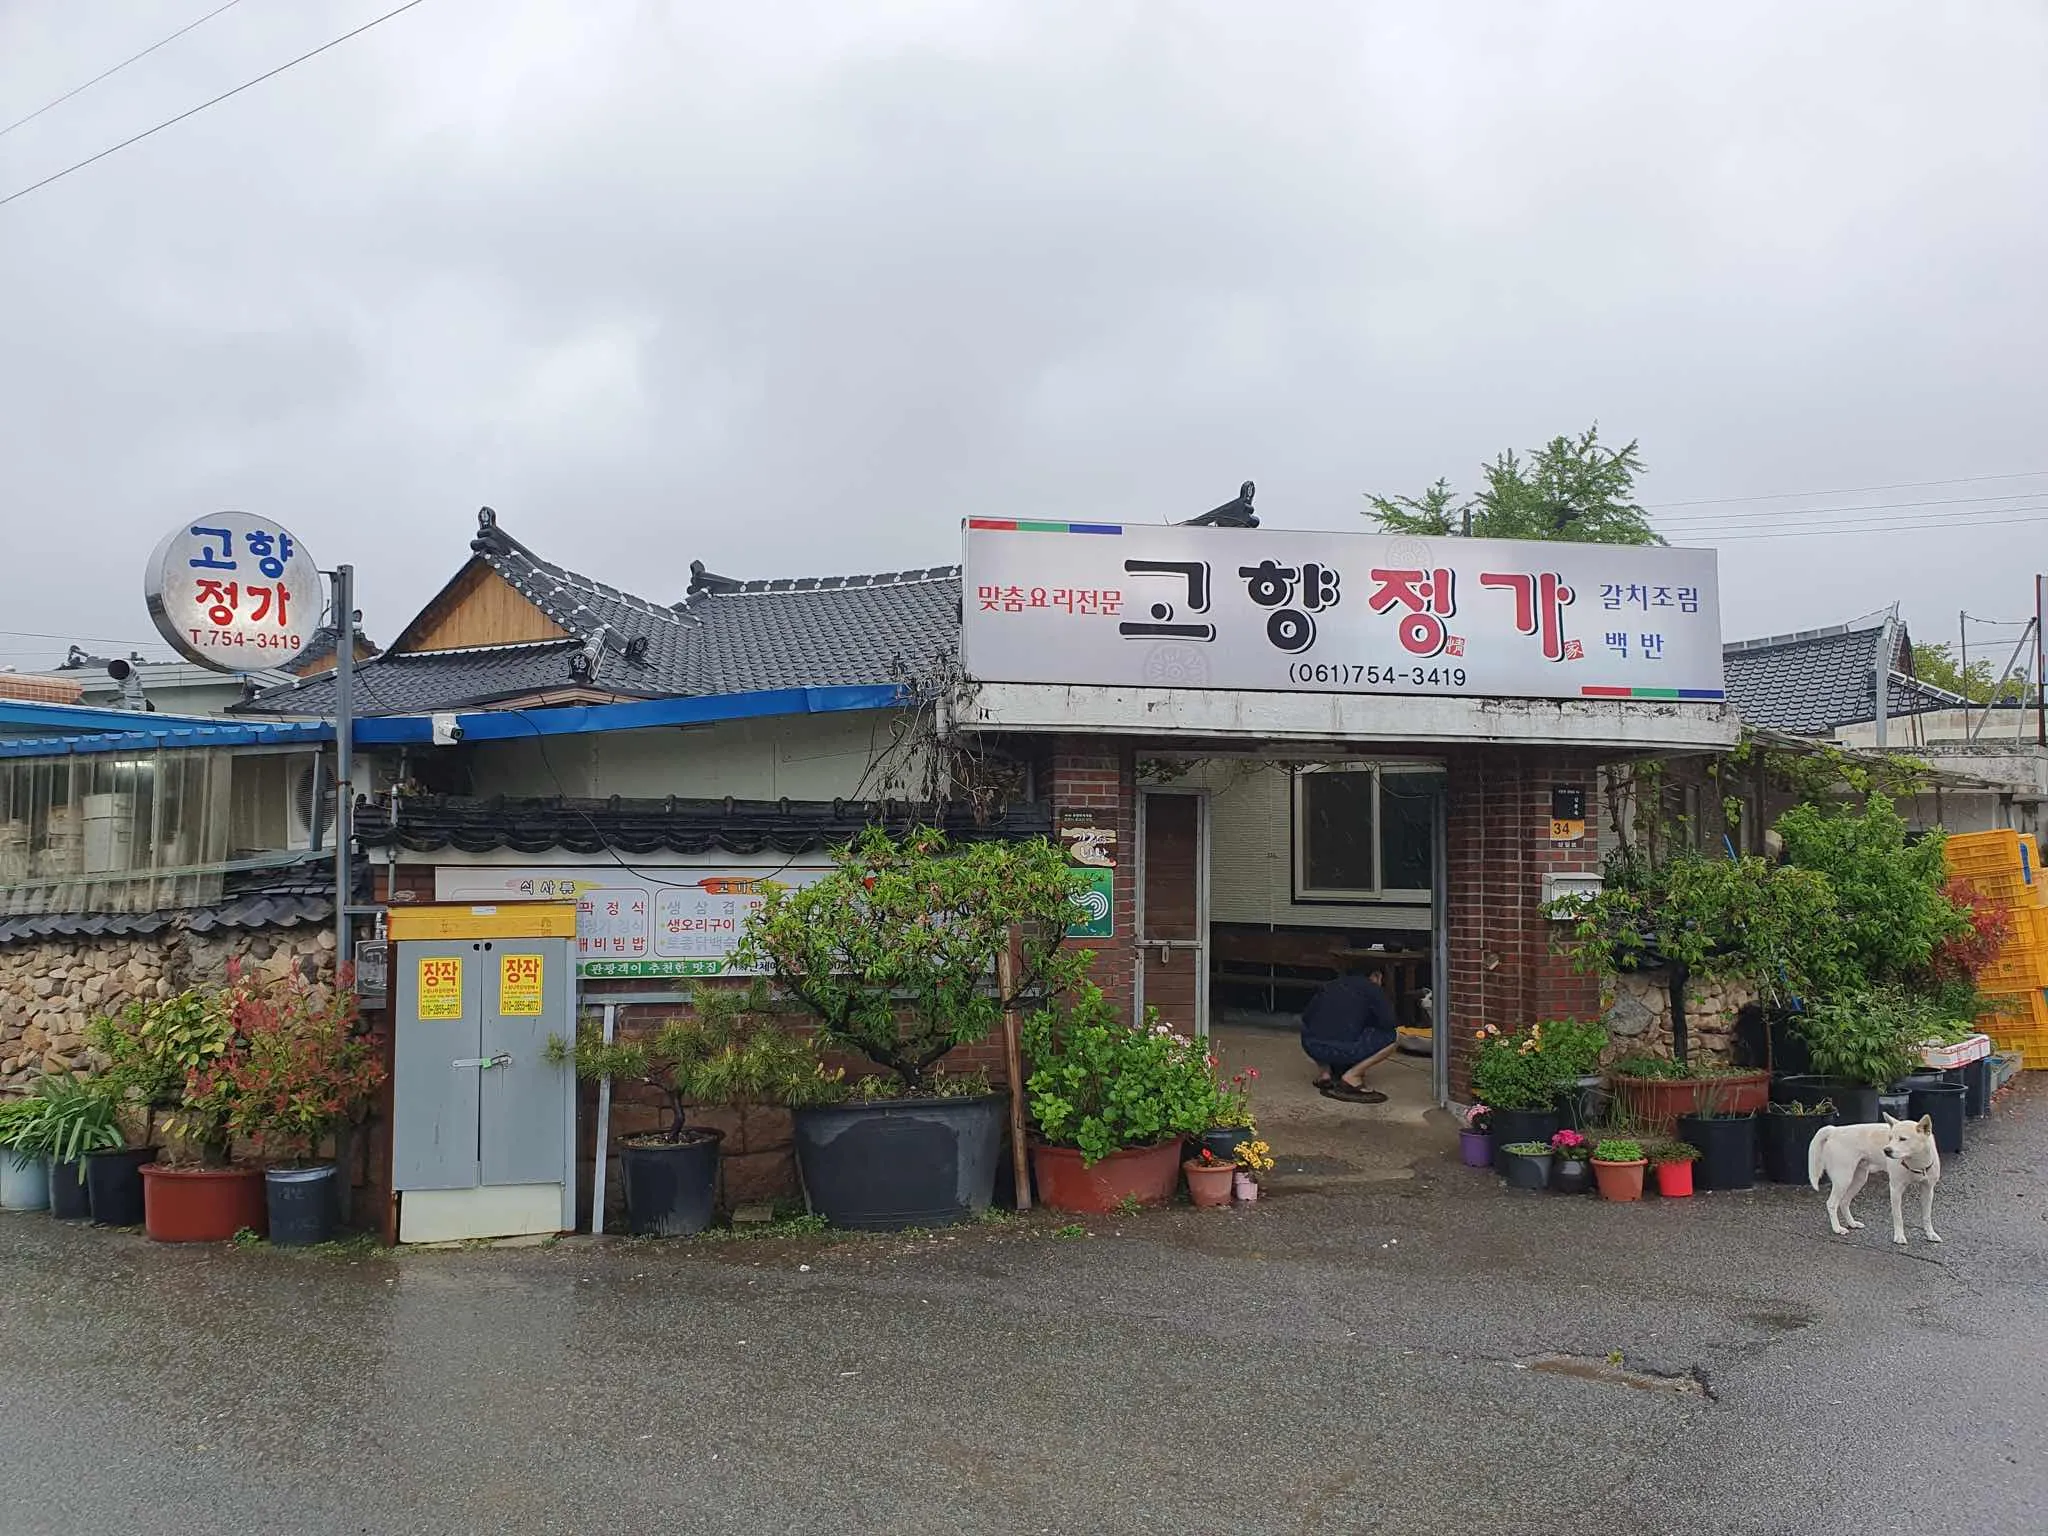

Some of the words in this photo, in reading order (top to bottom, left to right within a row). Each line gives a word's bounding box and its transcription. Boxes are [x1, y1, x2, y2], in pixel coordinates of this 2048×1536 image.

[189, 526, 293, 578] 고향
[196, 579, 291, 626] 정가
[978, 584, 1124, 616] 맞춤요리전문
[1599, 583, 1698, 613] 갈치조림
[1119, 559, 1341, 654] 고향
[1368, 567, 1576, 663] 정가
[189, 629, 301, 650] T.754-3419
[1289, 662, 1467, 687] (061)754-3419
[1553, 822, 1570, 835] 34
[667, 918, 736, 933] 생오리구이
[424, 961, 458, 986] 장작
[506, 958, 540, 984] 장작
[648, 962, 687, 974] 추천한
[692, 961, 717, 973] 맛집
